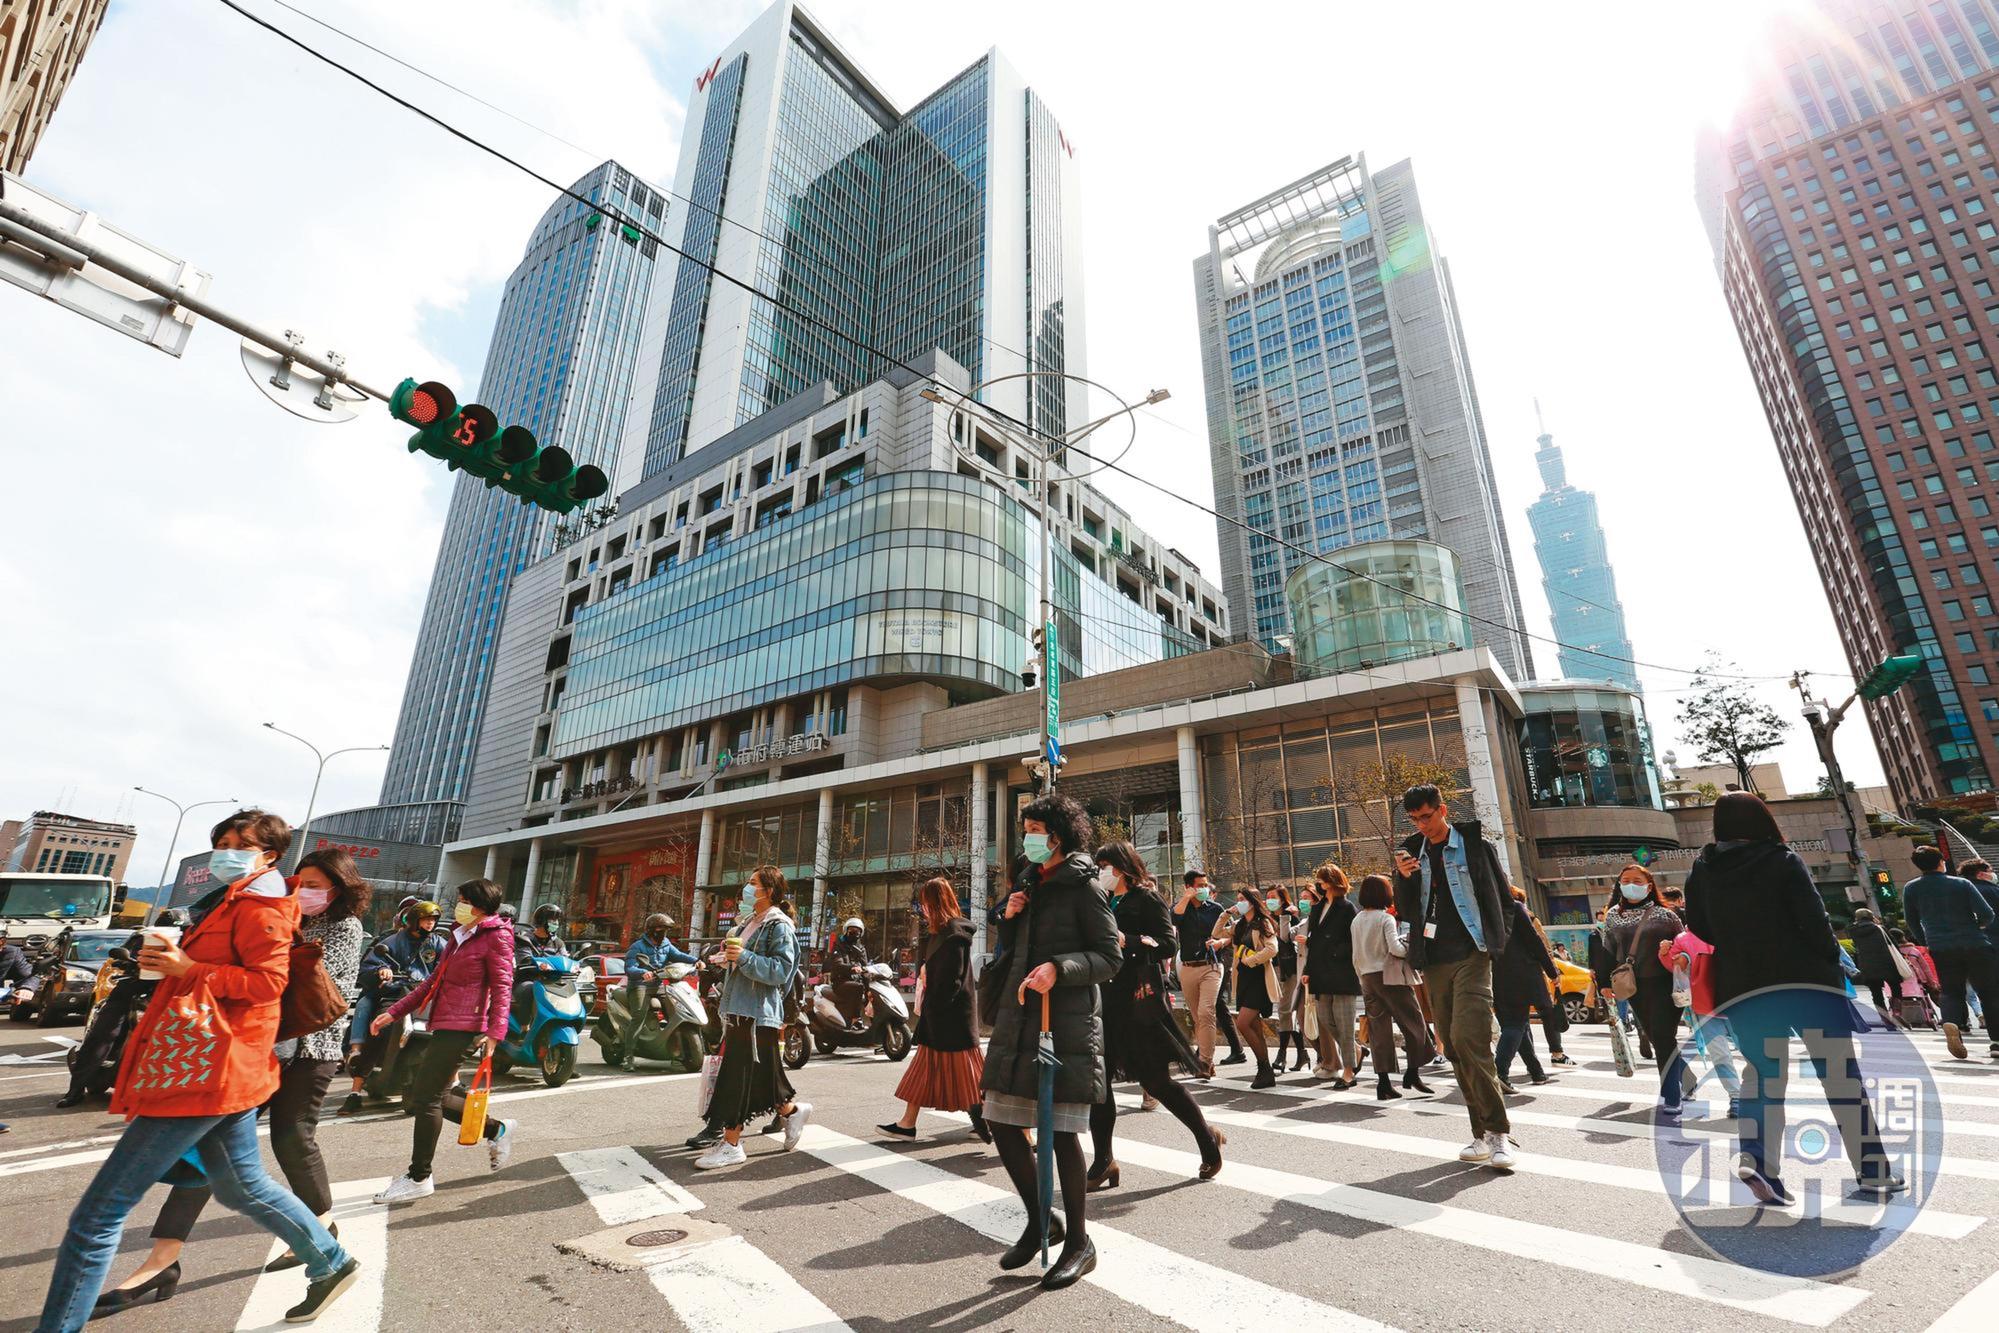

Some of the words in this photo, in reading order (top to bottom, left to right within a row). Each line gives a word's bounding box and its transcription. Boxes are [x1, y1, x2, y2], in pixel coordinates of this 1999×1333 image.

[697, 56, 722, 93] W
[735, 731, 824, 767] 市府轉運站
[1789, 839, 1827, 851] ATION
[1878, 872, 1889, 883] 18
